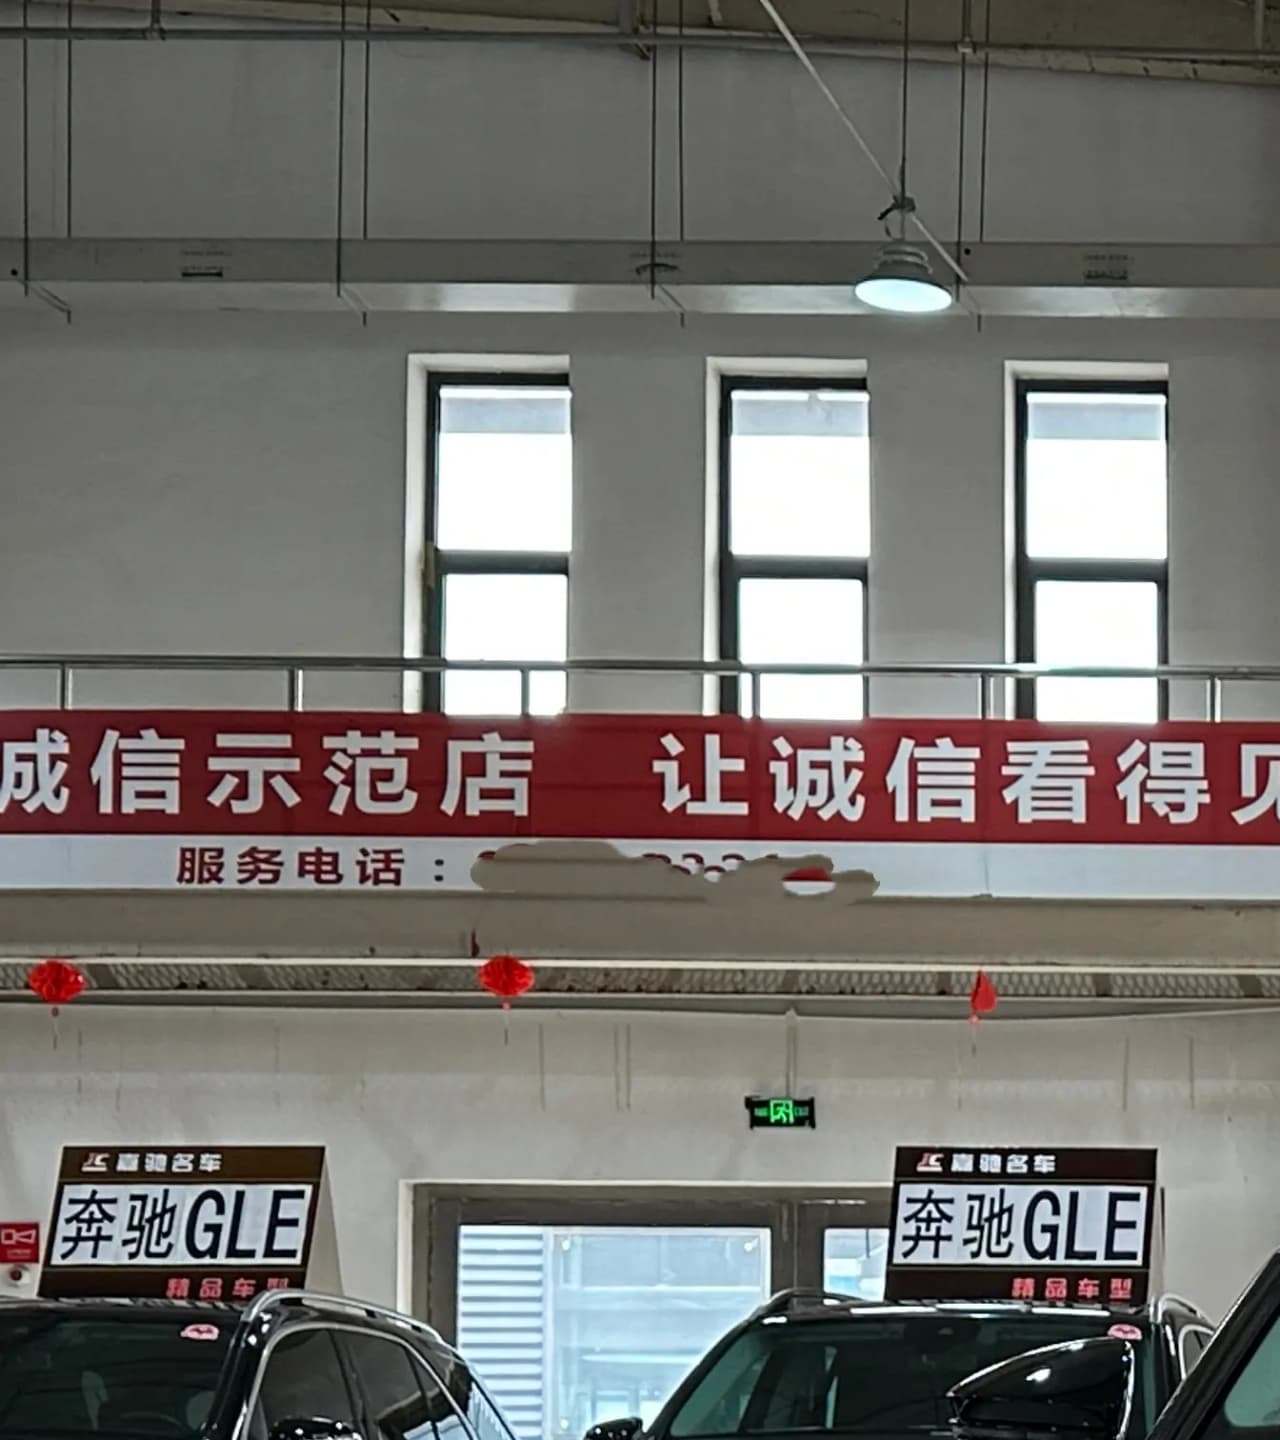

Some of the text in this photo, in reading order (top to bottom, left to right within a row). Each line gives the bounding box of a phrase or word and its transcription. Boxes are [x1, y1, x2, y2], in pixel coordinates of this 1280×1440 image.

[60, 1188, 306, 1260] 奔驰GLE
[901, 1188, 1142, 1261] 奔驰GLE
[1012, 1277, 1133, 1299] 精品车型
